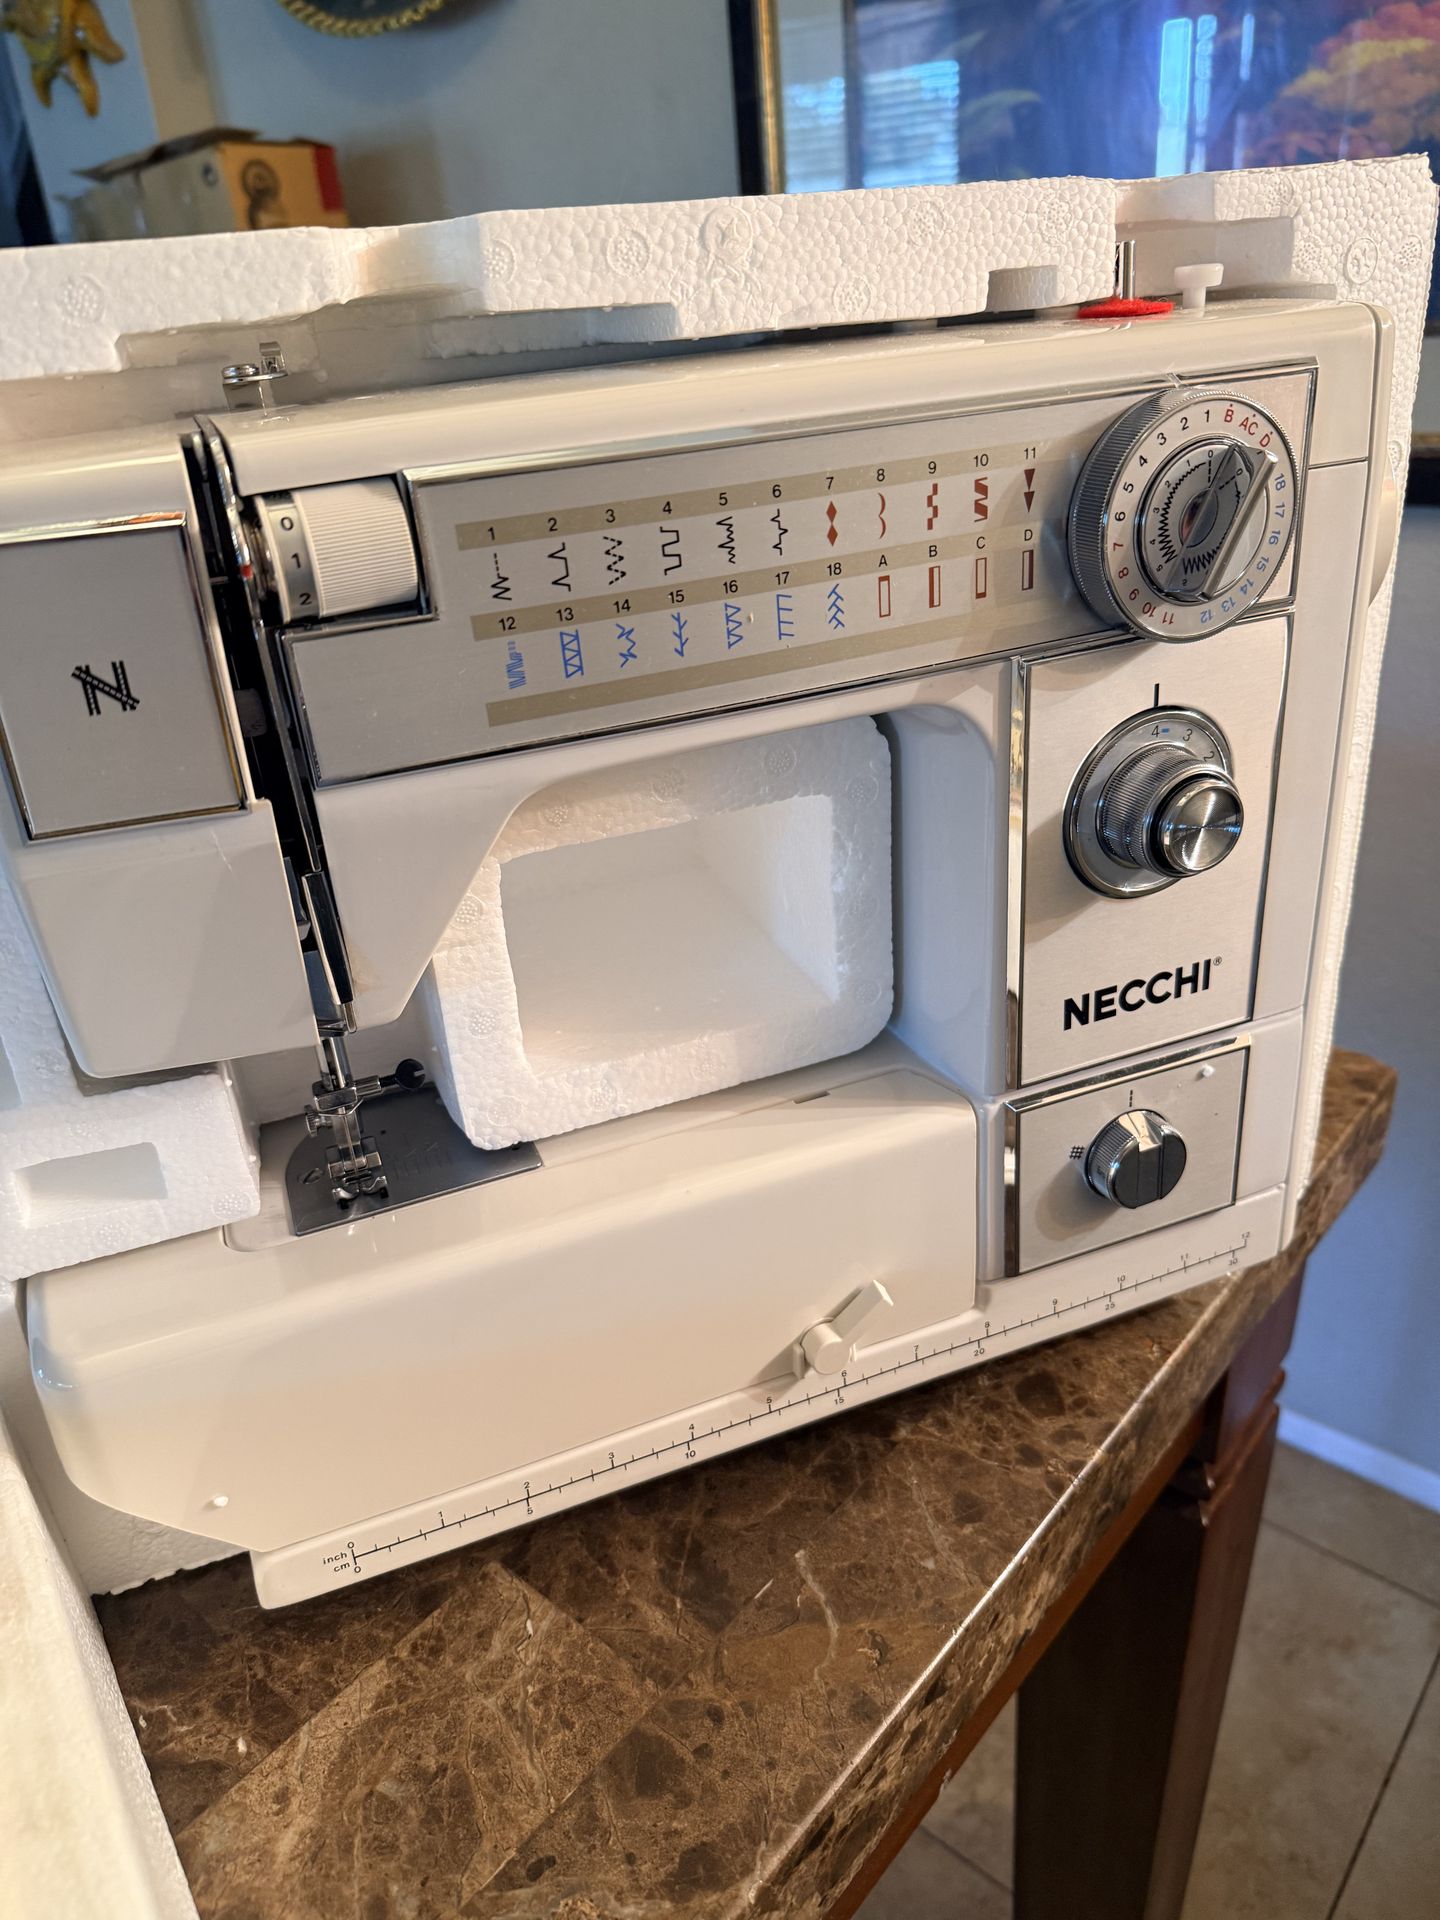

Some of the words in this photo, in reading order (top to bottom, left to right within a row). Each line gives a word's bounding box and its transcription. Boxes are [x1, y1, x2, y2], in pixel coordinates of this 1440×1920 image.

[1204, 410, 1211, 423] 1
[1224, 408, 1235, 423] B
[1180, 416, 1190, 431] 2
[1157, 432, 1167, 446] 3
[1259, 433, 1272, 448] D
[1138, 454, 1148, 468] 4
[1207, 450, 1214, 459] 0
[1123, 482, 1134, 494] 5
[1164, 480, 1172, 489] 2
[1275, 473, 1286, 491] 18
[487, 526, 496, 541] 1
[547, 517, 558, 532] 2
[605, 509, 616, 524] 3
[662, 501, 673, 516] 4
[718, 492, 729, 506] 5
[772, 484, 782, 499] 6
[826, 477, 835, 490] 7
[876, 468, 886, 483] 8
[928, 461, 937, 475] 9
[973, 453, 989, 468] 10
[1024, 447, 1037, 460] 11
[1115, 511, 1126, 521] 6
[1275, 502, 1285, 518] 17
[280, 516, 294, 531] 0
[1268, 529, 1281, 546] 16
[1112, 542, 1124, 551] 7
[291, 552, 301, 569] 1
[1256, 556, 1270, 573] 15
[1118, 566, 1129, 579] 8
[498, 616, 517, 632] 12
[556, 607, 574, 622] 13
[613, 599, 632, 614] 14
[669, 589, 685, 604] 15
[723, 580, 739, 594] 16
[775, 571, 790, 586] 17
[826, 562, 842, 577] 18
[878, 554, 888, 569] A
[928, 545, 938, 558] B
[976, 536, 987, 550] C
[1024, 529, 1034, 542] D
[1239, 578, 1255, 595] 14
[299, 592, 312, 606] 2
[1128, 588, 1140, 602] 9
[1142, 601, 1158, 615] 10
[1220, 597, 1237, 612] 13
[1161, 611, 1174, 625] 11
[1199, 608, 1214, 624] 12
[1151, 725, 1160, 738] 4
[1182, 728, 1193, 742] 3
[1203, 750, 1215, 762] 2
[347, 1541, 355, 1549] 0
[523, 1481, 531, 1489] 2
[688, 1423, 695, 1431] 4
[984, 1321, 991, 1329] 8
[1117, 1275, 1126, 1283] 10
[1181, 1253, 1189, 1261] 11
[1241, 1231, 1250, 1239] 12
[354, 1566, 362, 1574] 0
[527, 1507, 534, 1515] 5
[684, 1450, 696, 1459] 10
[834, 1397, 844, 1405] 15
[973, 1348, 985, 1357] 20
[1105, 1303, 1116, 1311] 25
[322, 1552, 348, 1565] inch
[333, 1561, 351, 1573] cm
